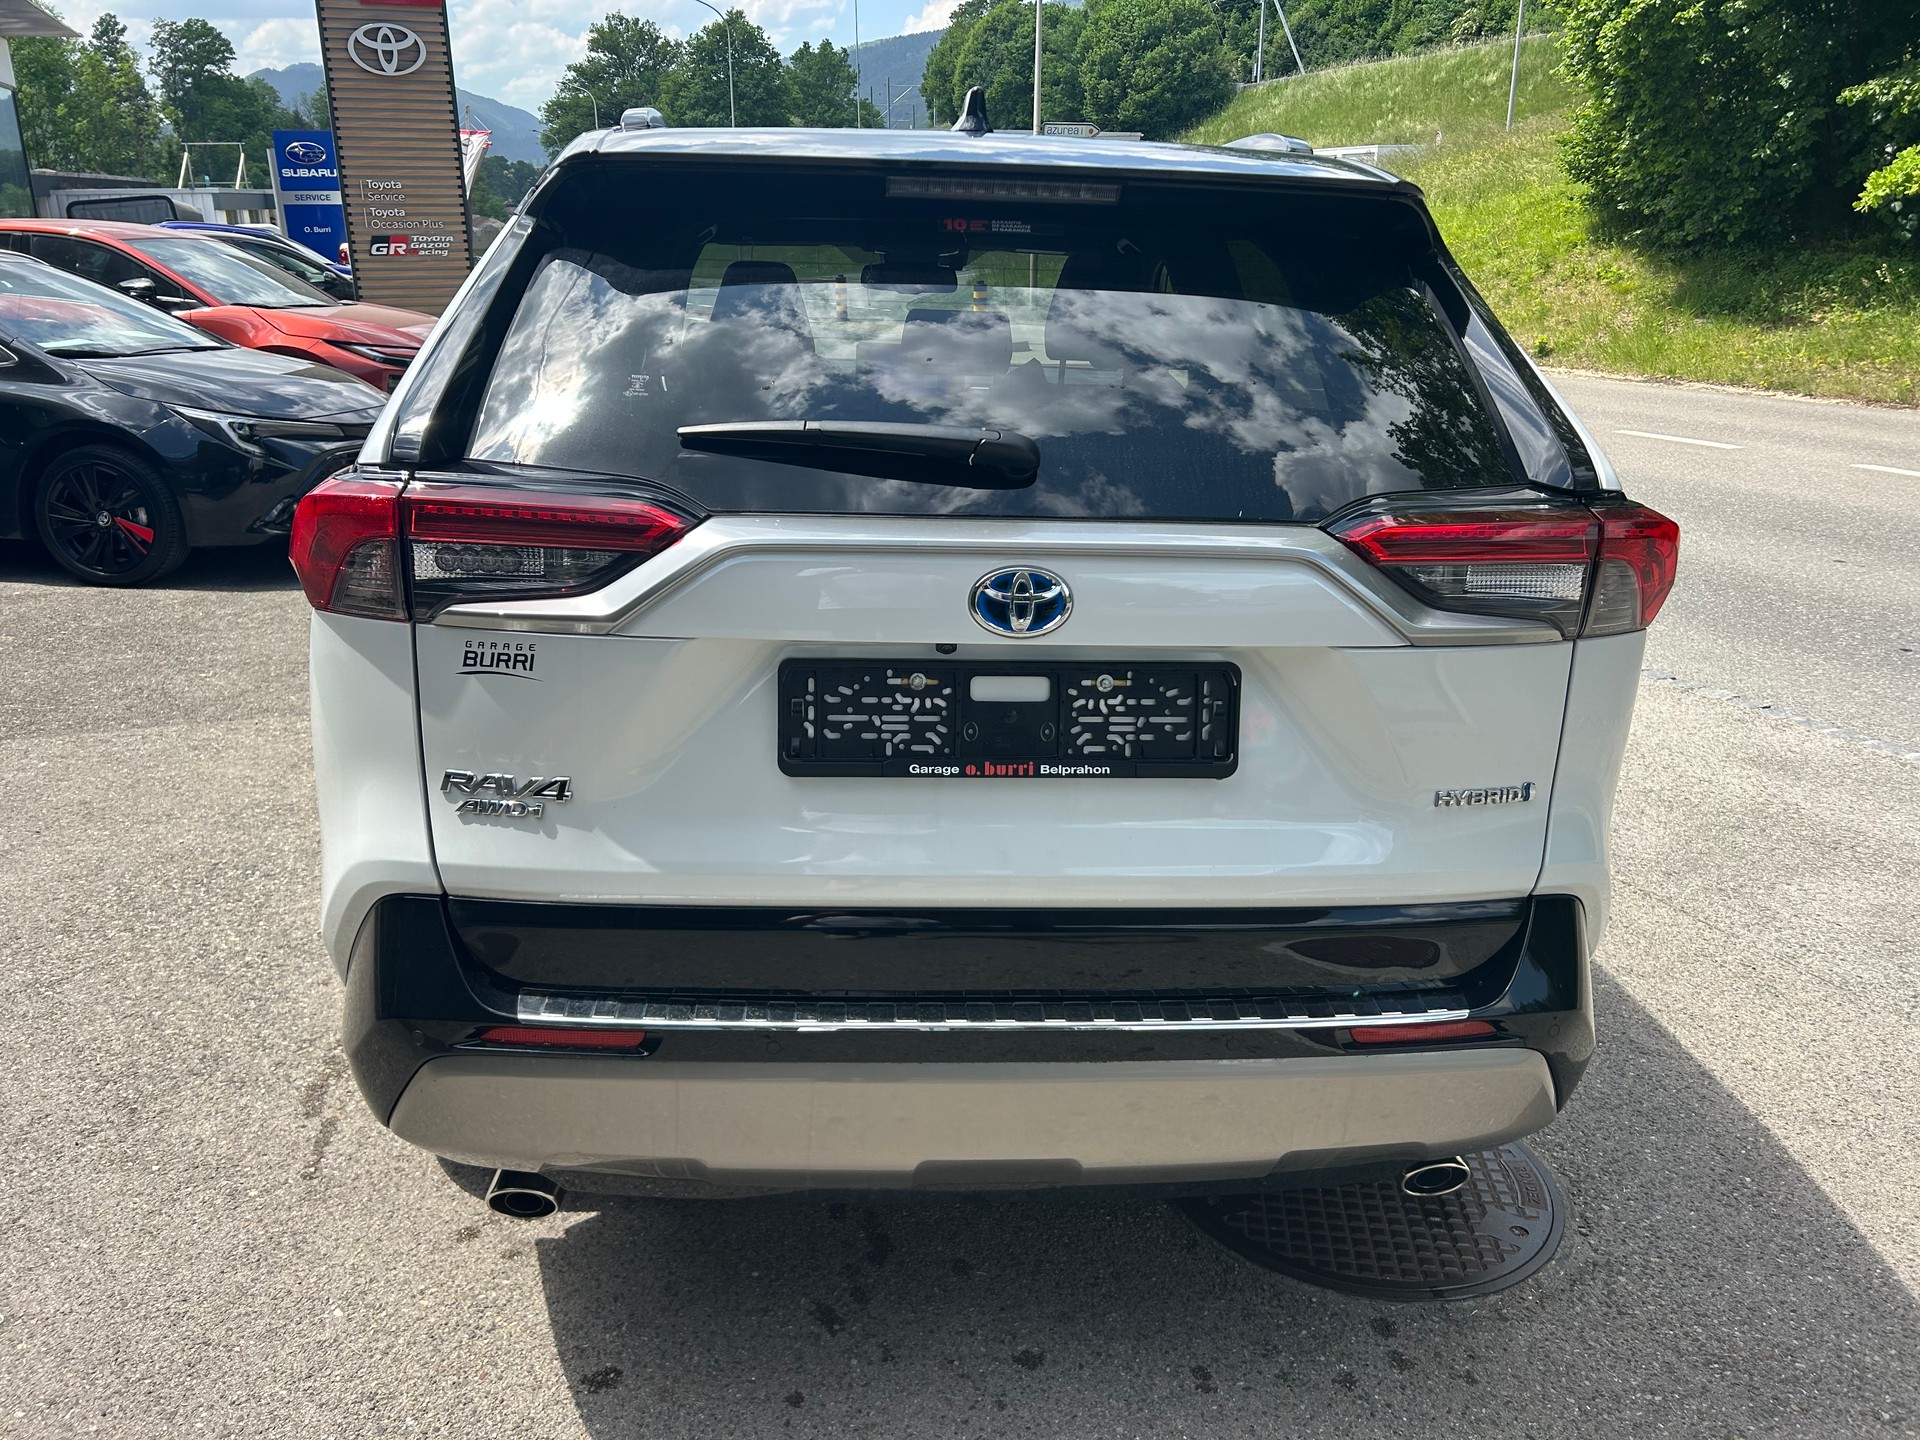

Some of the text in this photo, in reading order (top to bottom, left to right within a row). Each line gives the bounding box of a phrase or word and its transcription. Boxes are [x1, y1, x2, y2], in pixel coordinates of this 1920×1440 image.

[281, 168, 337, 177] SUBARU
[366, 179, 402, 191] Toyota
[294, 193, 331, 201] SERVICE
[367, 191, 406, 201] Service
[369, 207, 406, 218] Toyota
[371, 219, 444, 229] Occasion Plus
[944, 218, 967, 231] 10
[371, 243, 407, 255] GR
[410, 248, 449, 257] Racing
[465, 640, 536, 651] GARAGE
[462, 650, 535, 672] BURRI
[909, 764, 960, 776] Garage
[984, 761, 1034, 776] burri
[1040, 764, 1111, 776] Belprahon
[440, 769, 573, 803] RAV4
